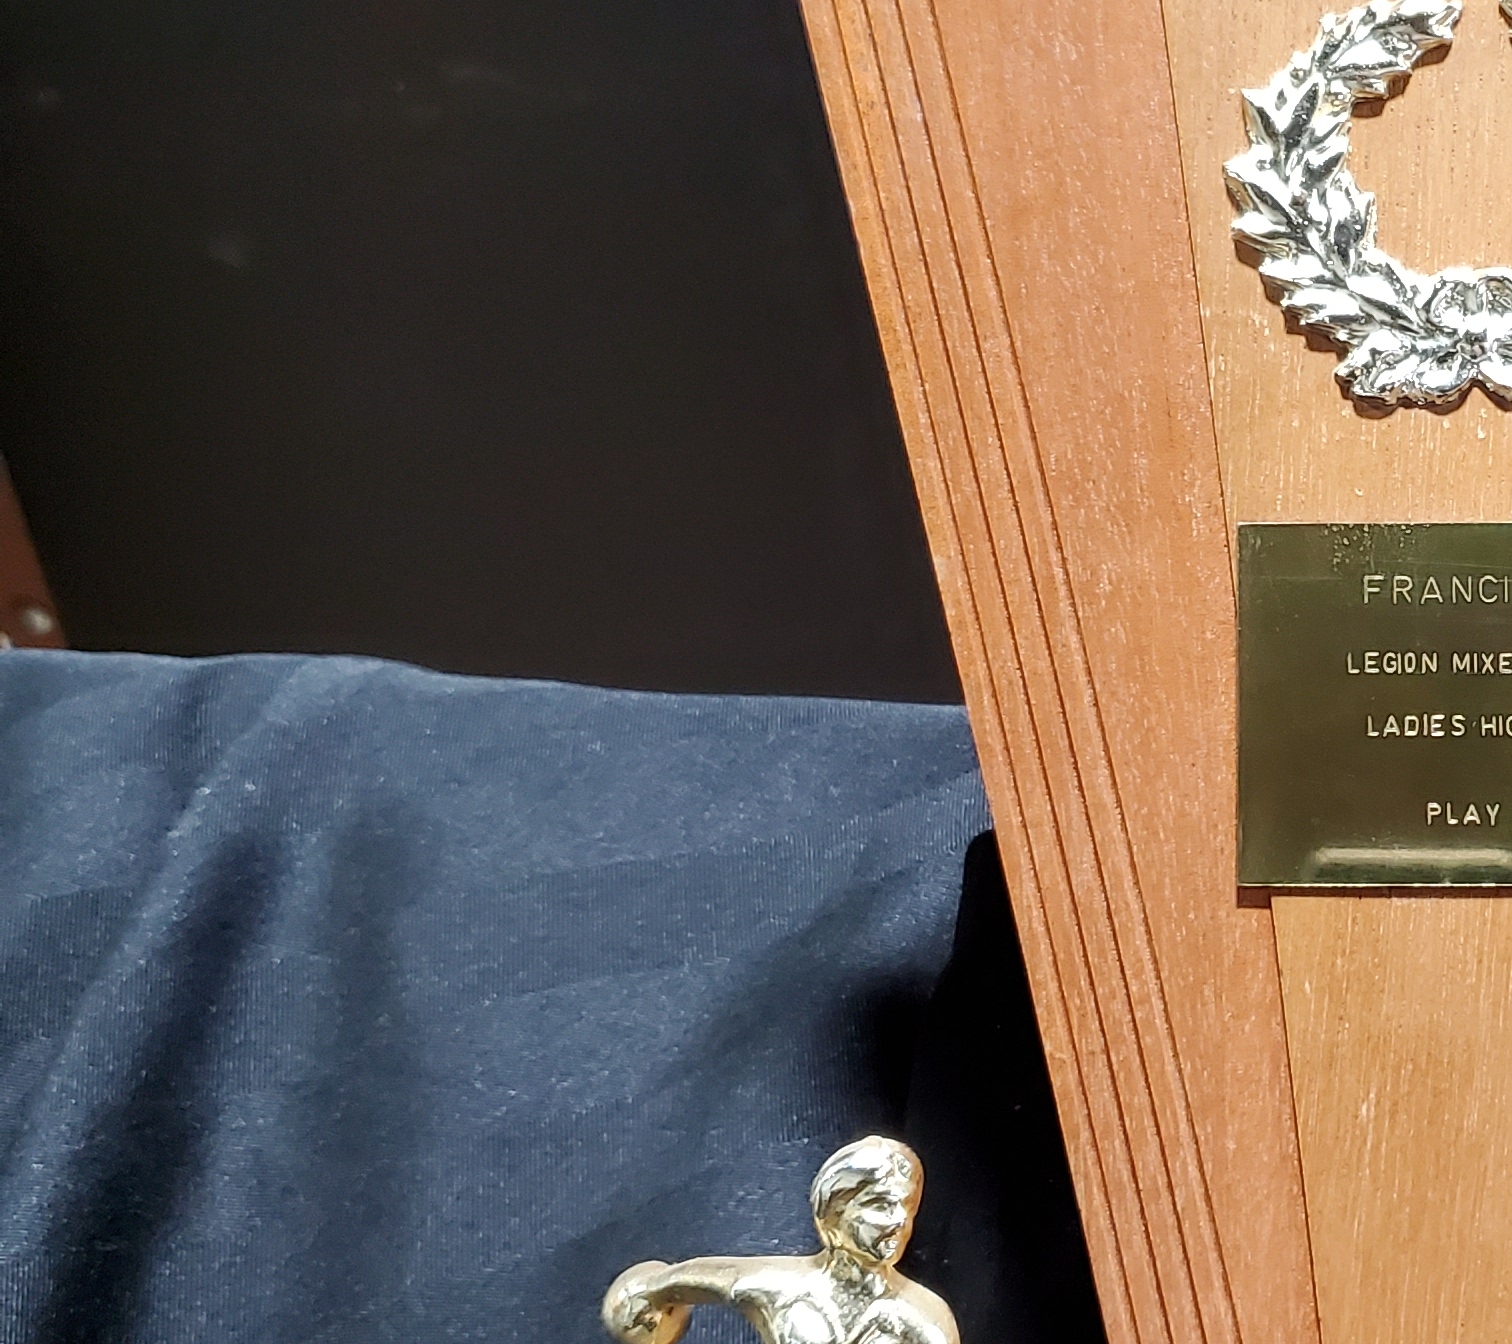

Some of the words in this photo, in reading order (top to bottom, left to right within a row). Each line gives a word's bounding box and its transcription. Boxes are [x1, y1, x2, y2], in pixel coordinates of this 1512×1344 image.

[1346, 652, 1438, 675] LEGION
[1367, 714, 1466, 738] LADIES
[1426, 803, 1499, 825] PLAY
